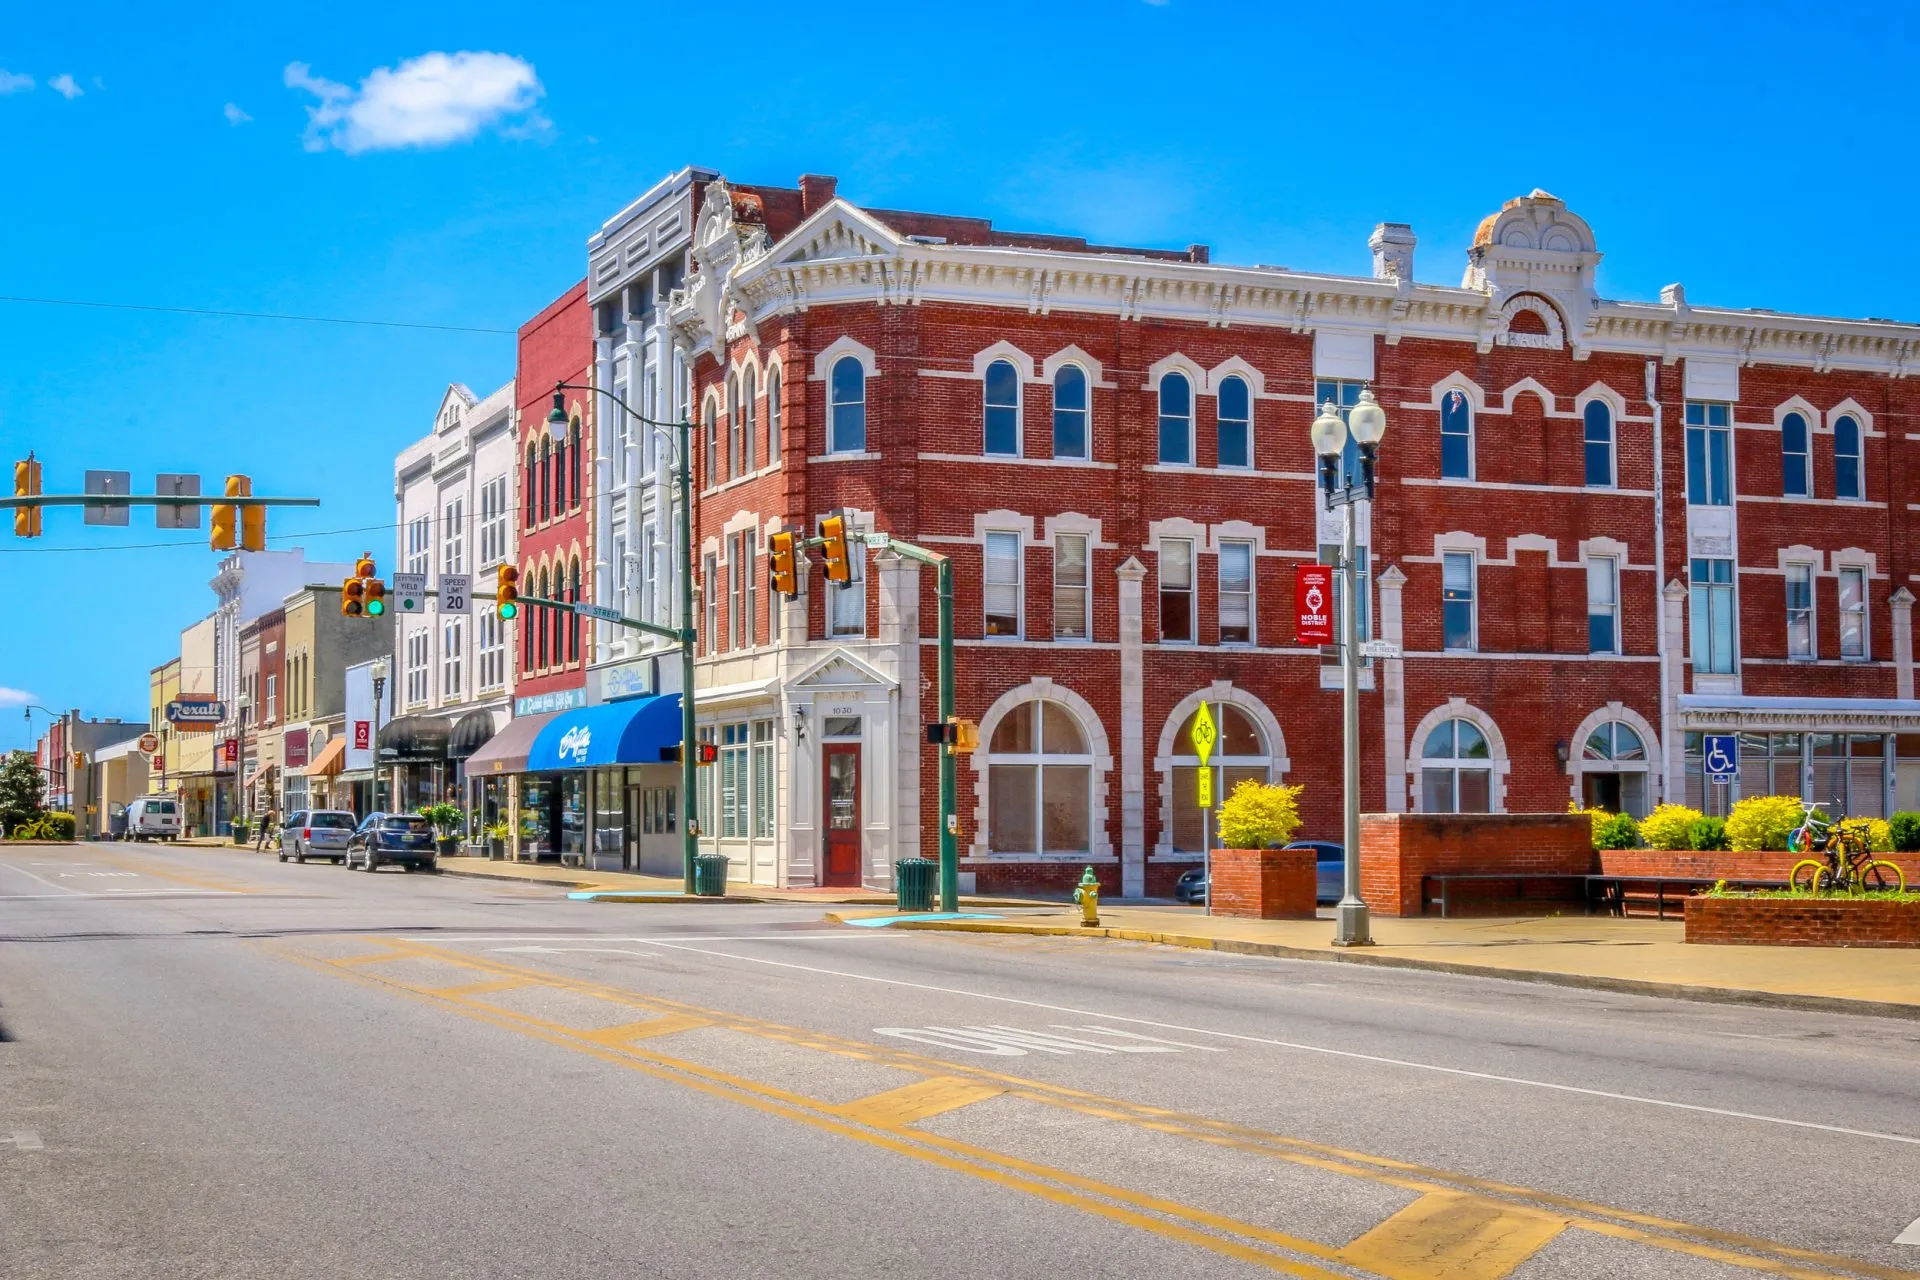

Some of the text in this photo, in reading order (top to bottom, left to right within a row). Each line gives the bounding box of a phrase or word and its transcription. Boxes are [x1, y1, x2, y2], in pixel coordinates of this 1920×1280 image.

[444, 578, 466, 586] SPEED
[446, 596, 464, 609] 20
[593, 607, 620, 619] STREET
[170, 702, 222, 720] Rexall
[832, 706, 852, 715] 1030
[872, 1025, 1229, 1056] ONLY
